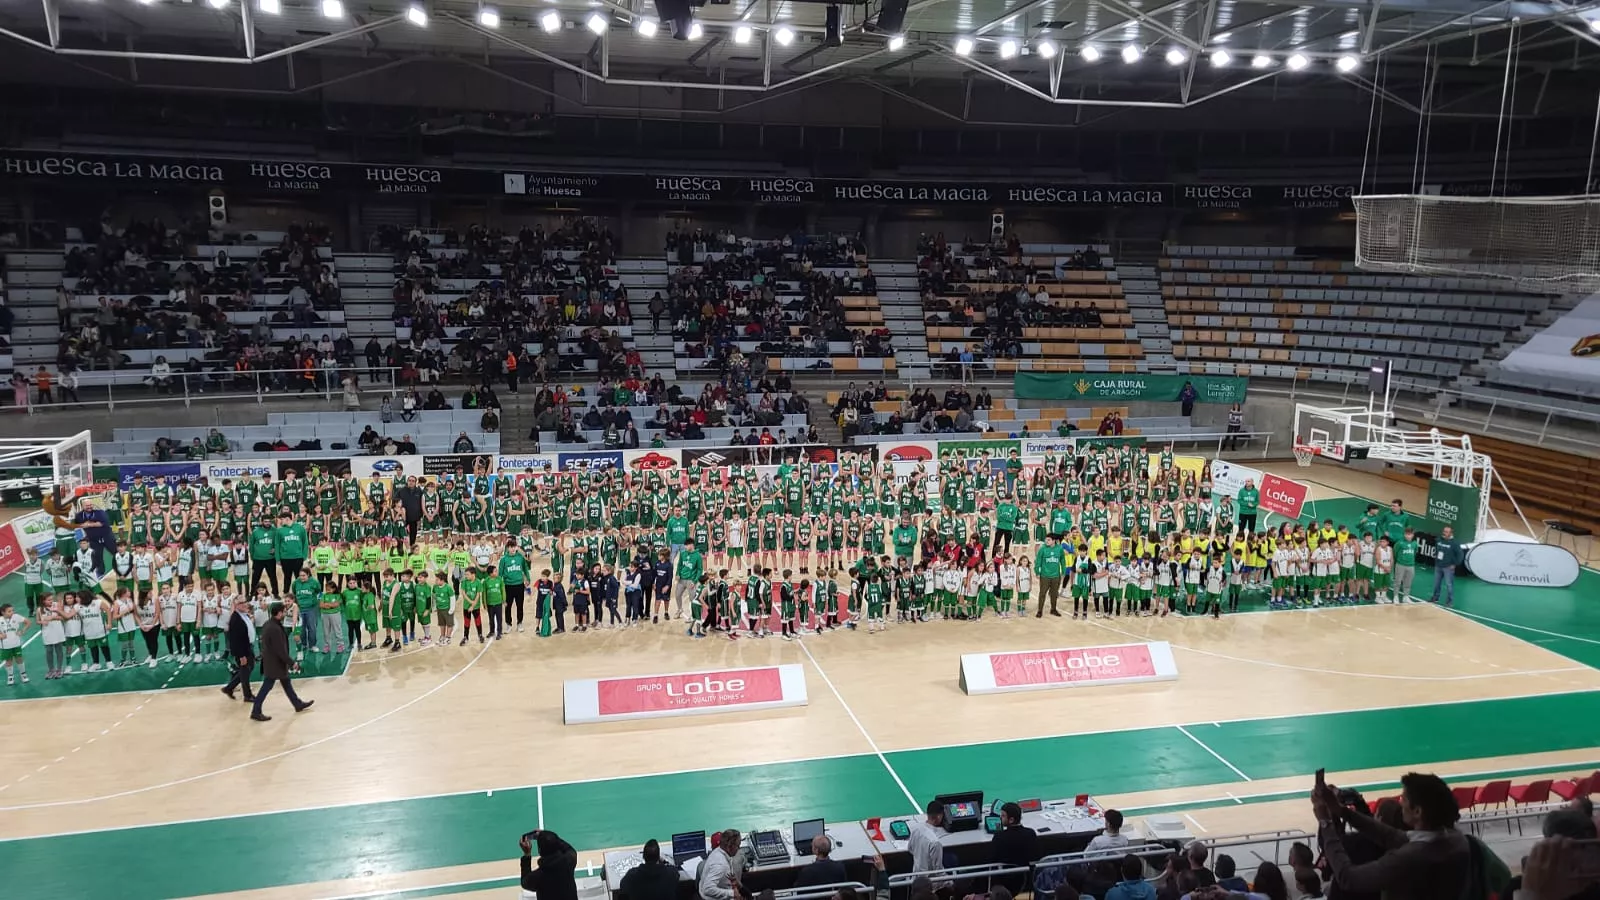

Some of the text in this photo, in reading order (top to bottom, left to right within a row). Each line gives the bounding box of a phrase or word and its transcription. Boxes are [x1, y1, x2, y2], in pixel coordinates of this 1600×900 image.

[528, 174, 598, 187] Ayuntamiento
[528, 186, 582, 197] de Huesca
[1094, 380, 1147, 389] CAJA RURAL
[142, 472, 199, 484] ecmpter
[1266, 487, 1296, 505] Lobe
[1430, 498, 1459, 513] Lobe
[590, 509, 599, 517] 23
[1499, 571, 1550, 583] Aramóvil
[1050, 652, 1120, 671] Lobe
[636, 676, 745, 697] GRUPO Lobe
[694, 696, 717, 704] QUALITY
